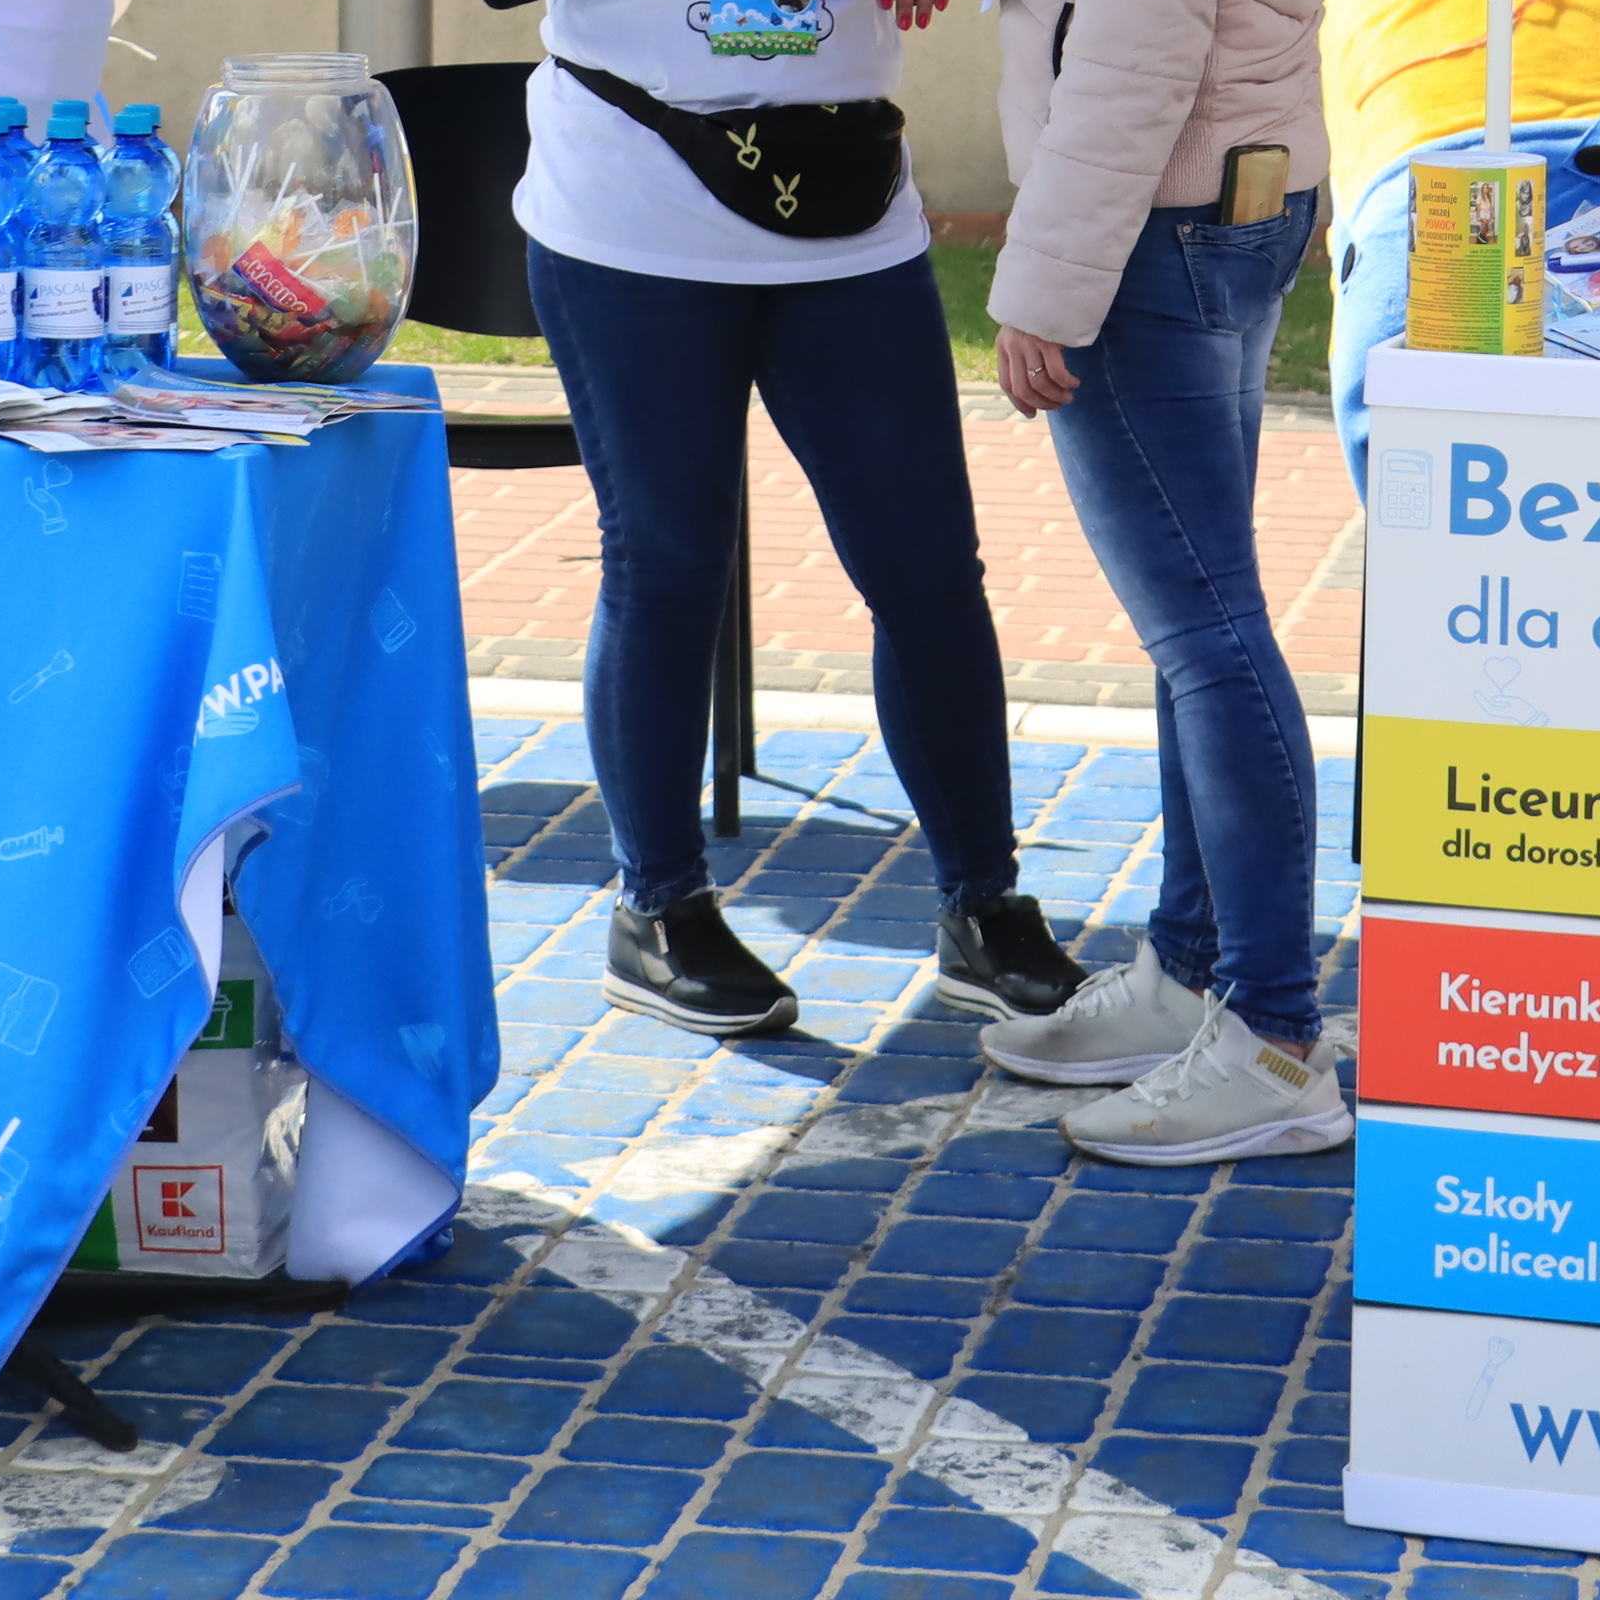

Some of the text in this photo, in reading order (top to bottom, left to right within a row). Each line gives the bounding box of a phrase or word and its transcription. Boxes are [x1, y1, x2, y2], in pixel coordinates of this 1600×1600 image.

[1430, 179, 1447, 190] Lena
[1422, 193, 1458, 205] potrzebuje
[1428, 207, 1451, 218] naszej
[1425, 219, 1457, 230] POMOCY
[39, 281, 88, 297] PASCAL
[248, 259, 310, 315] HARIBO
[1447, 575, 1560, 649] dla
[1442, 828, 1491, 860] dla
[1434, 1174, 1573, 1234] Szkoły
[147, 1224, 215, 1239] Kaufland
